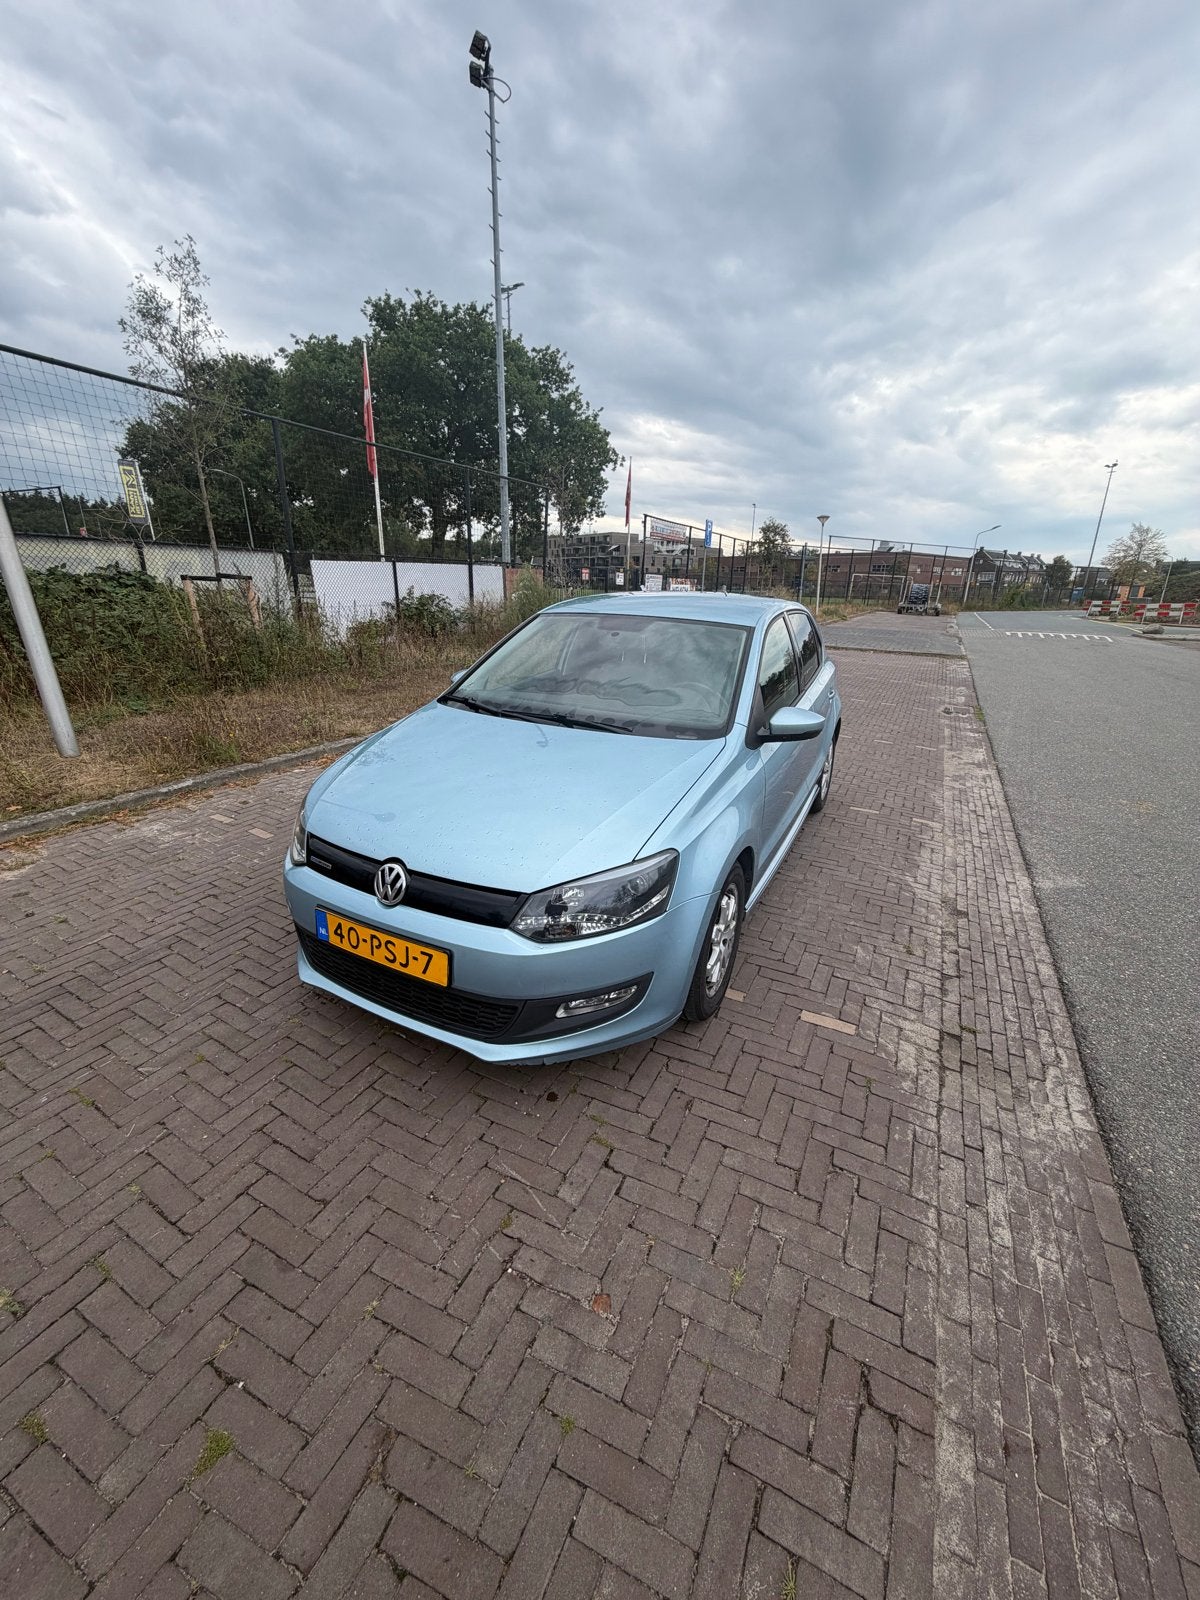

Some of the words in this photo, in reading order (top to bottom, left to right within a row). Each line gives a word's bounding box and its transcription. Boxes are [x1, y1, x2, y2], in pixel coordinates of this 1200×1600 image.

[375, 864, 406, 905] VW
[319, 926, 329, 937] NL
[333, 921, 434, 976] 40-PSJ-7
